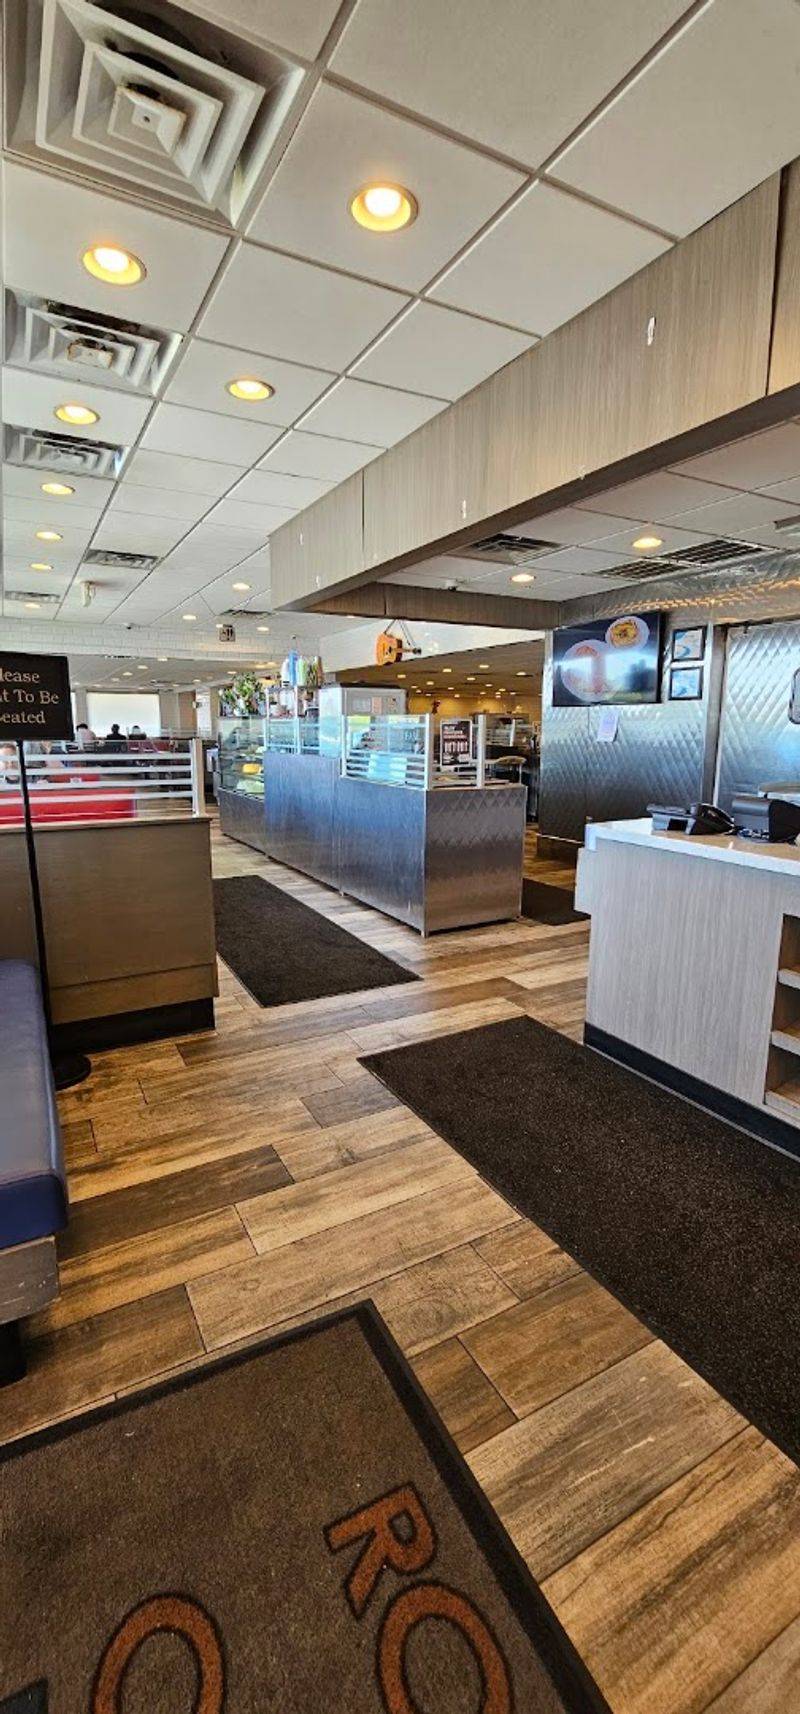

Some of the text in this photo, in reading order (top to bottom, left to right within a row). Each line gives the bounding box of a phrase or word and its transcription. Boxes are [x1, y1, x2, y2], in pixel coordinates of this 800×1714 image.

[0, 667, 40, 683] lease
[13, 688, 35, 703] To
[39, 690, 60, 704] Be
[0, 710, 46, 724] eated
